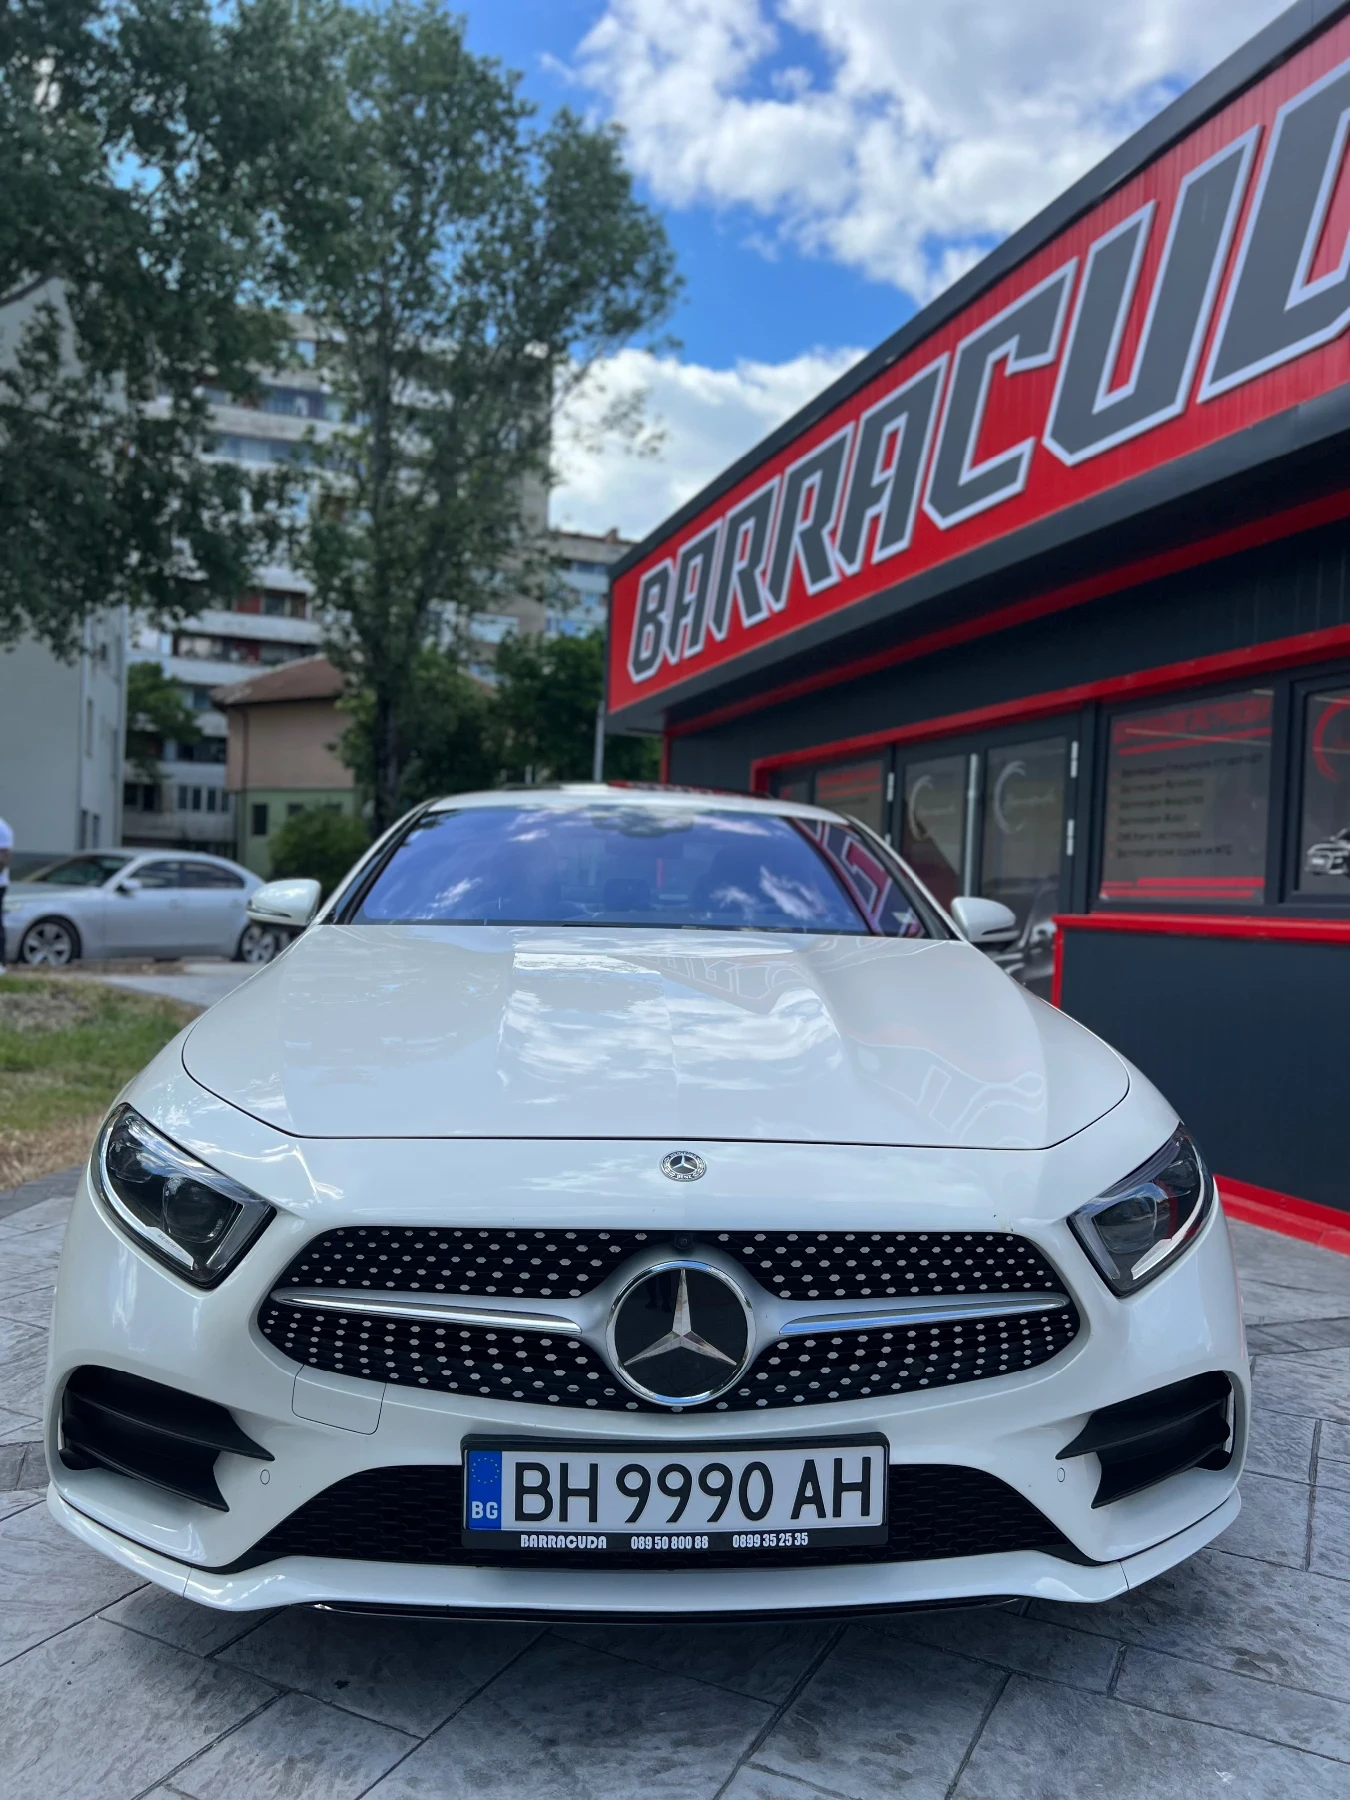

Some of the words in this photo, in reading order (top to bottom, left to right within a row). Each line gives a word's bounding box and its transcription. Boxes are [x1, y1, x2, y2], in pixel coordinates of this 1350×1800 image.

[514, 1461, 599, 1523] BH
[615, 1461, 774, 1524] 9990
[790, 1456, 872, 1520] AH
[471, 1501, 498, 1519] BG
[520, 1534, 607, 1549] BARRACUDA
[630, 1534, 653, 1550] 089
[654, 1535, 669, 1550] 50
[670, 1535, 693, 1550] 800
[694, 1535, 709, 1549] 88
[732, 1533, 761, 1548] 0899
[762, 1533, 777, 1547] 35
[778, 1532, 793, 1547] 25
[794, 1532, 809, 1546] 35
